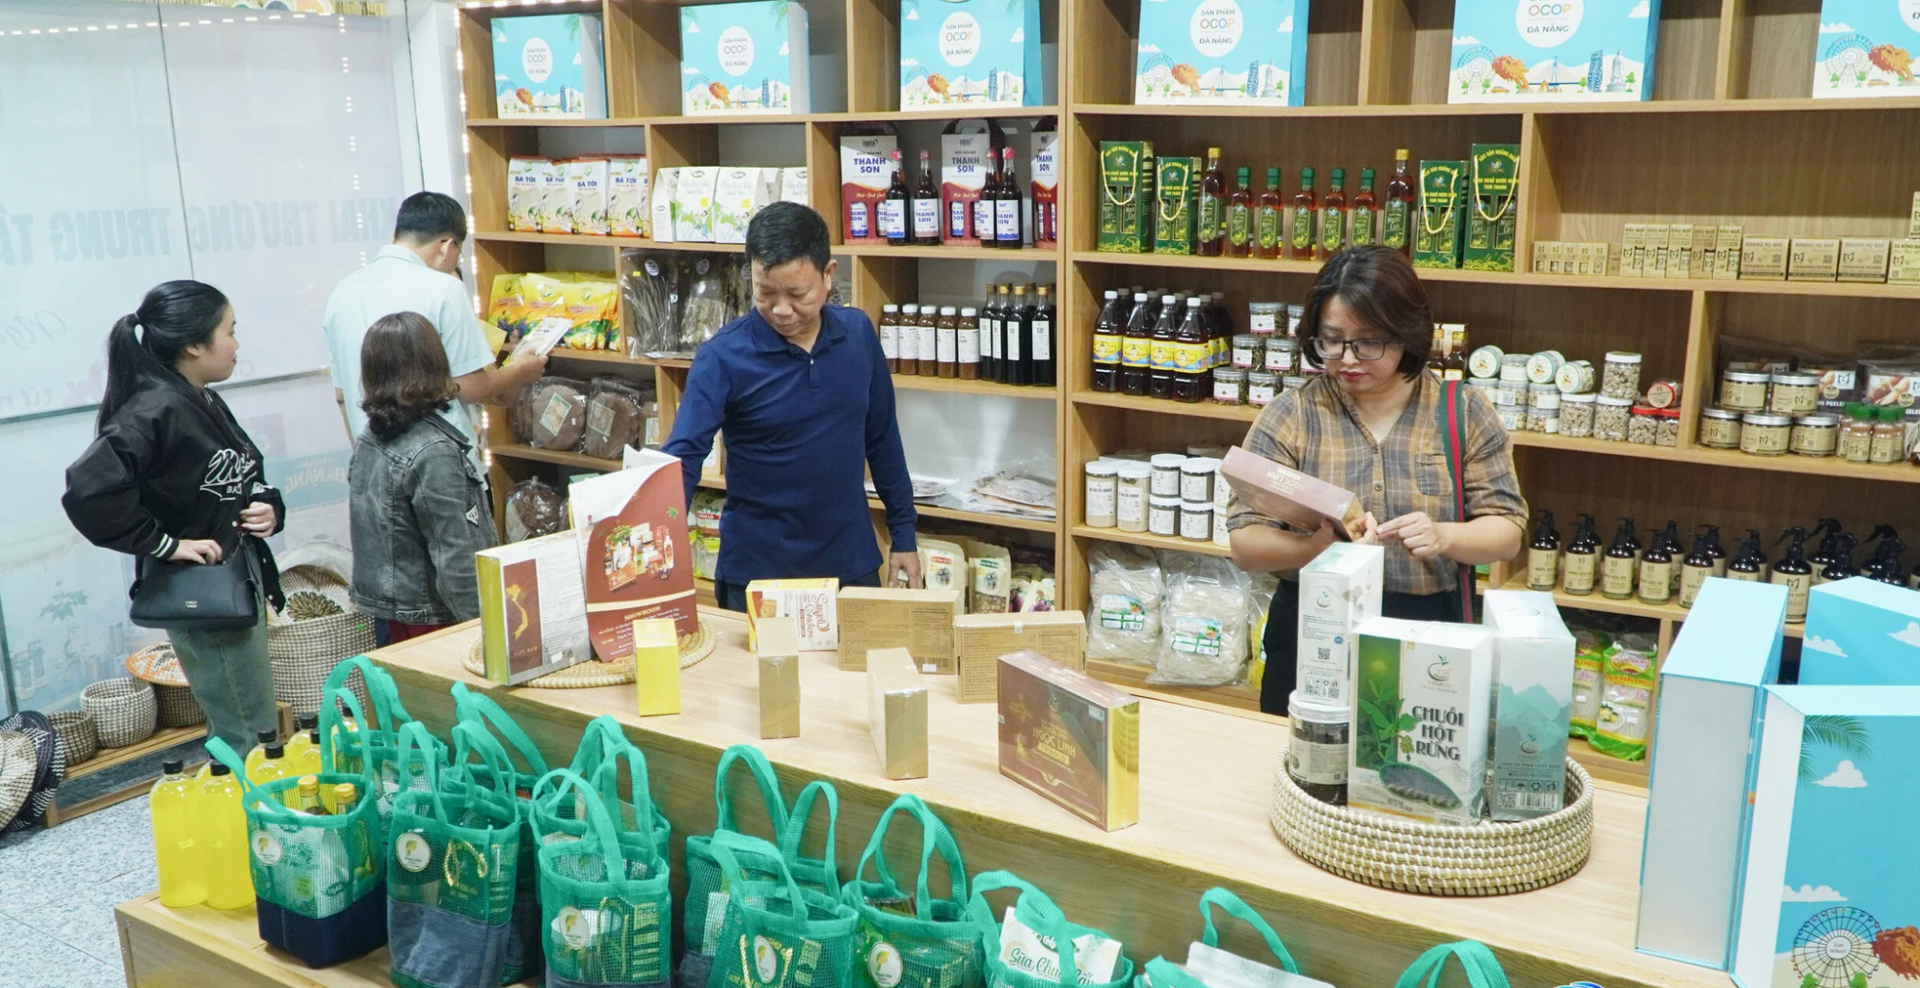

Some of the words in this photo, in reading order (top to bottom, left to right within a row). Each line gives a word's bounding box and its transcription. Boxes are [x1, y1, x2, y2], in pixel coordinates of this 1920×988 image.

[1528, 4, 1571, 16] OCOP
[1200, 18, 1234, 29] OCOP
[946, 31, 973, 42] OCOP
[724, 44, 748, 54] OCOP
[624, 606, 661, 622] SHOWROOM
[1412, 705, 1464, 727] CHUỐI
[1421, 724, 1457, 743] HỘT
[1057, 739, 1076, 758] LINH
[1416, 740, 1461, 762] RỪNG
[1008, 947, 1033, 968] Sữa
[1036, 957, 1061, 980] Chu
